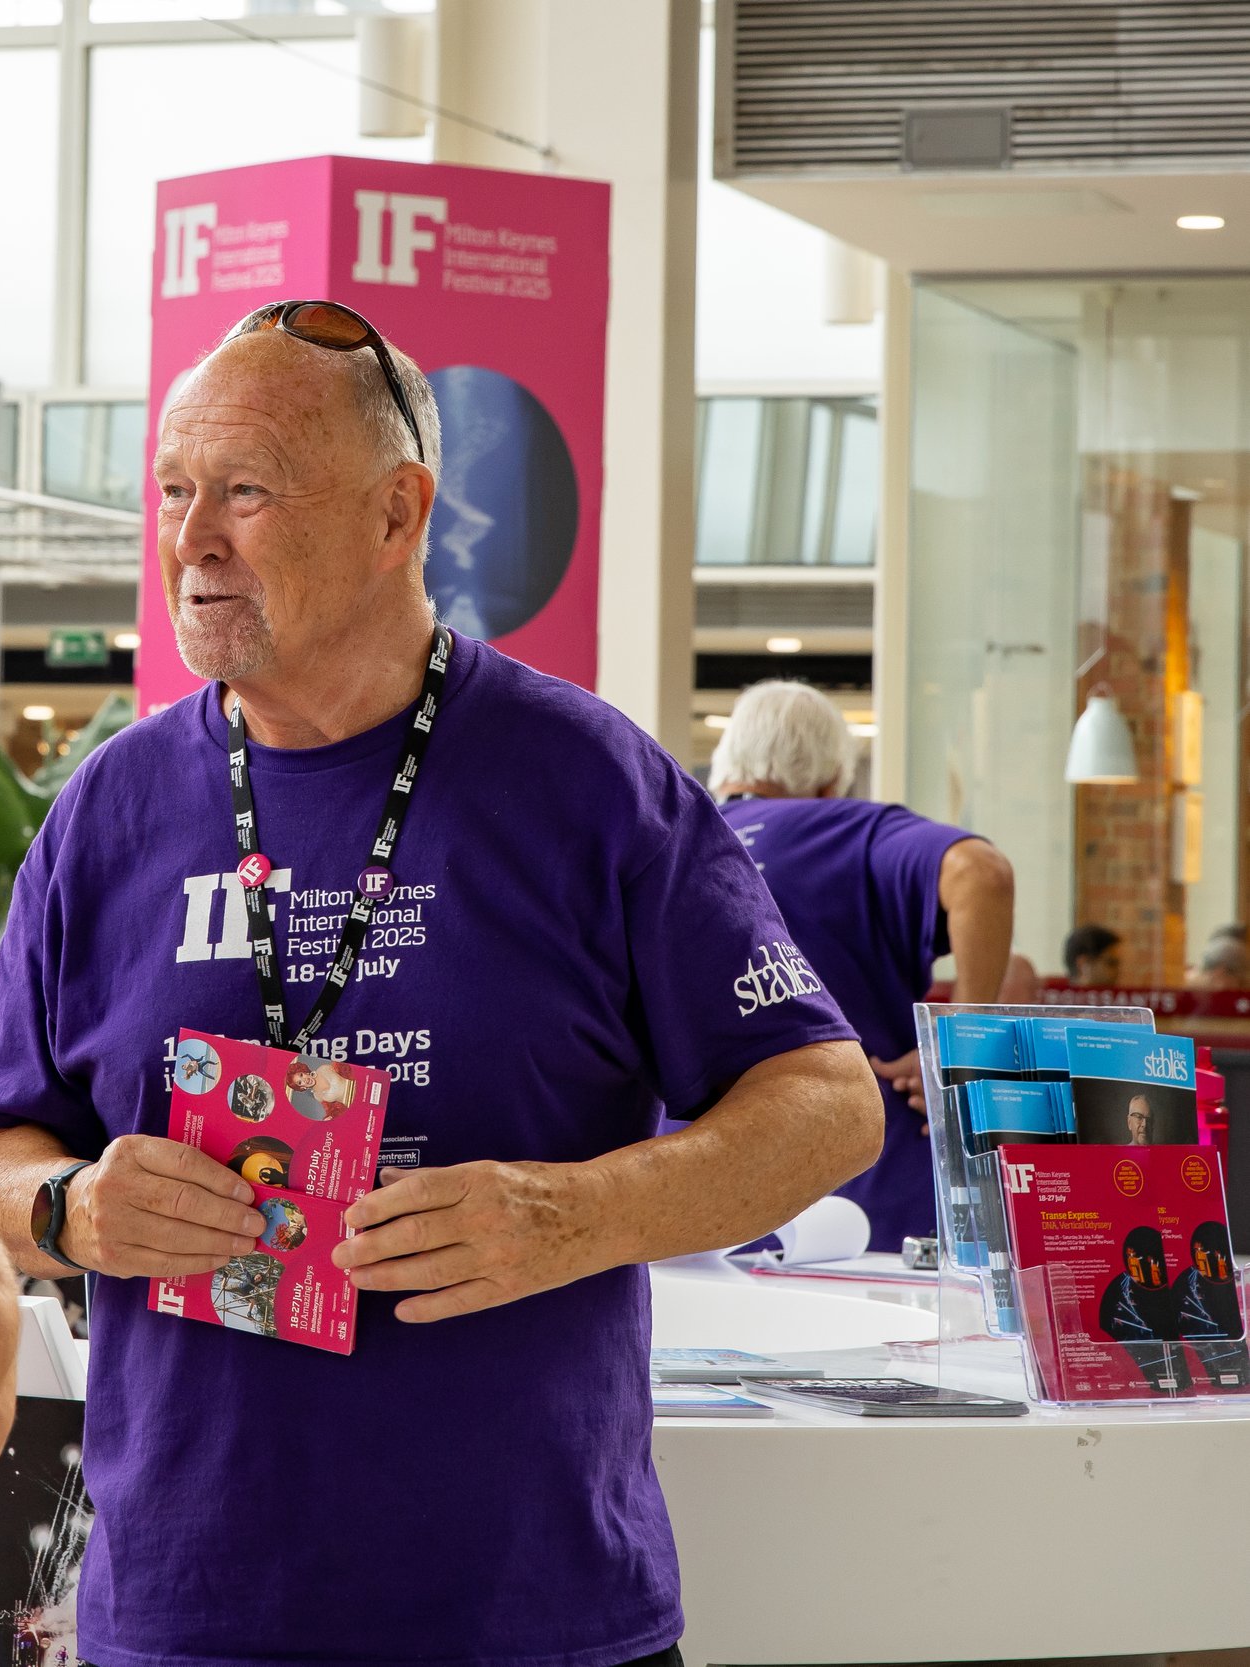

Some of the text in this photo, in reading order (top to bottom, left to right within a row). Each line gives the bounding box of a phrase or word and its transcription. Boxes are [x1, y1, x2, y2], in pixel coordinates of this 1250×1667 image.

[352, 189, 448, 287] IF
[161, 202, 218, 300] IF
[429, 652, 446, 673] IF
[414, 711, 432, 732] IF
[229, 748, 244, 766] IF
[393, 773, 412, 794] IF
[236, 810, 253, 828] IF
[372, 837, 392, 858] IF
[240, 856, 263, 884] IF
[366, 873, 388, 892] IF
[289, 889, 353, 909] Milton
[176, 868, 292, 963] IF
[351, 901, 370, 922] IF
[253, 938, 272, 955] IF
[372, 927, 426, 948] 2025
[781, 941, 800, 957] the
[330, 963, 347, 988] IF
[356, 956, 400, 982] July
[734, 942, 821, 1017] stables
[265, 1004, 284, 1023] IF
[293, 1028, 310, 1048] IF
[355, 1029, 430, 1058] Days
[1144, 1048, 1188, 1080] stables
[1174, 1050, 1186, 1060] the
[323, 1131, 334, 1152] Days
[310, 1149, 321, 1169] July
[317, 1152, 331, 1188] Amazing
[1007, 1164, 1035, 1194] IF
[1040, 1211, 1099, 1221] Transe Express:
[157, 1283, 184, 1317] IF
[290, 1282, 304, 1328] 18-27 July
[300, 1265, 313, 1330] 10 Amazing Days
